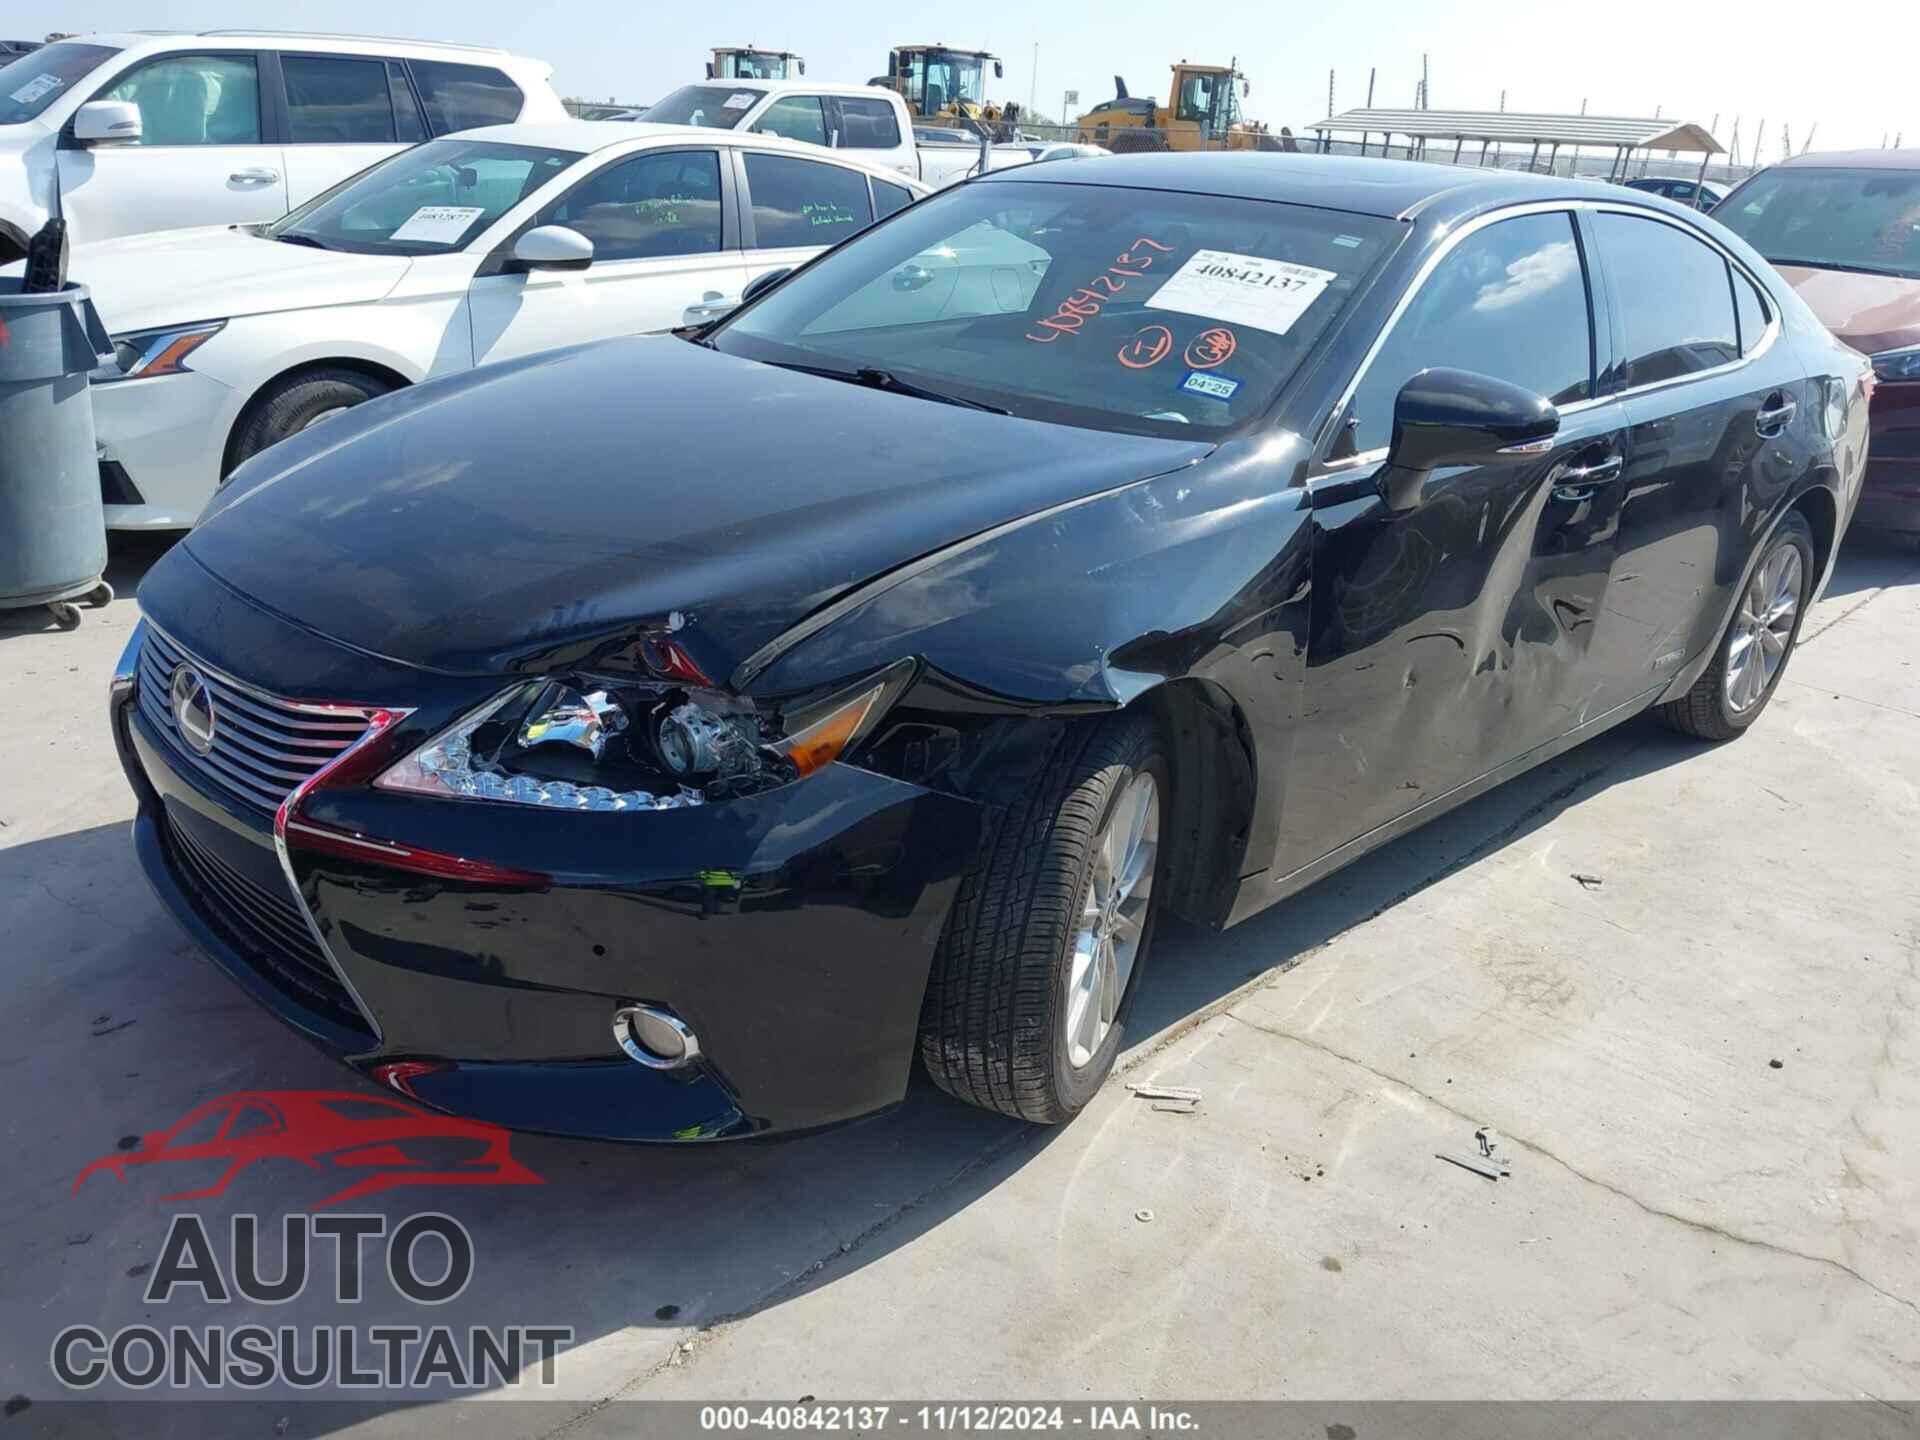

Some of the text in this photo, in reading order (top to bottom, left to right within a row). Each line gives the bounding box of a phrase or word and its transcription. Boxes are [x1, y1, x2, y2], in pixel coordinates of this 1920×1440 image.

[1194, 264, 1307, 292] 40842137
[1188, 378, 1206, 389] 04
[1210, 383, 1233, 396] 25
